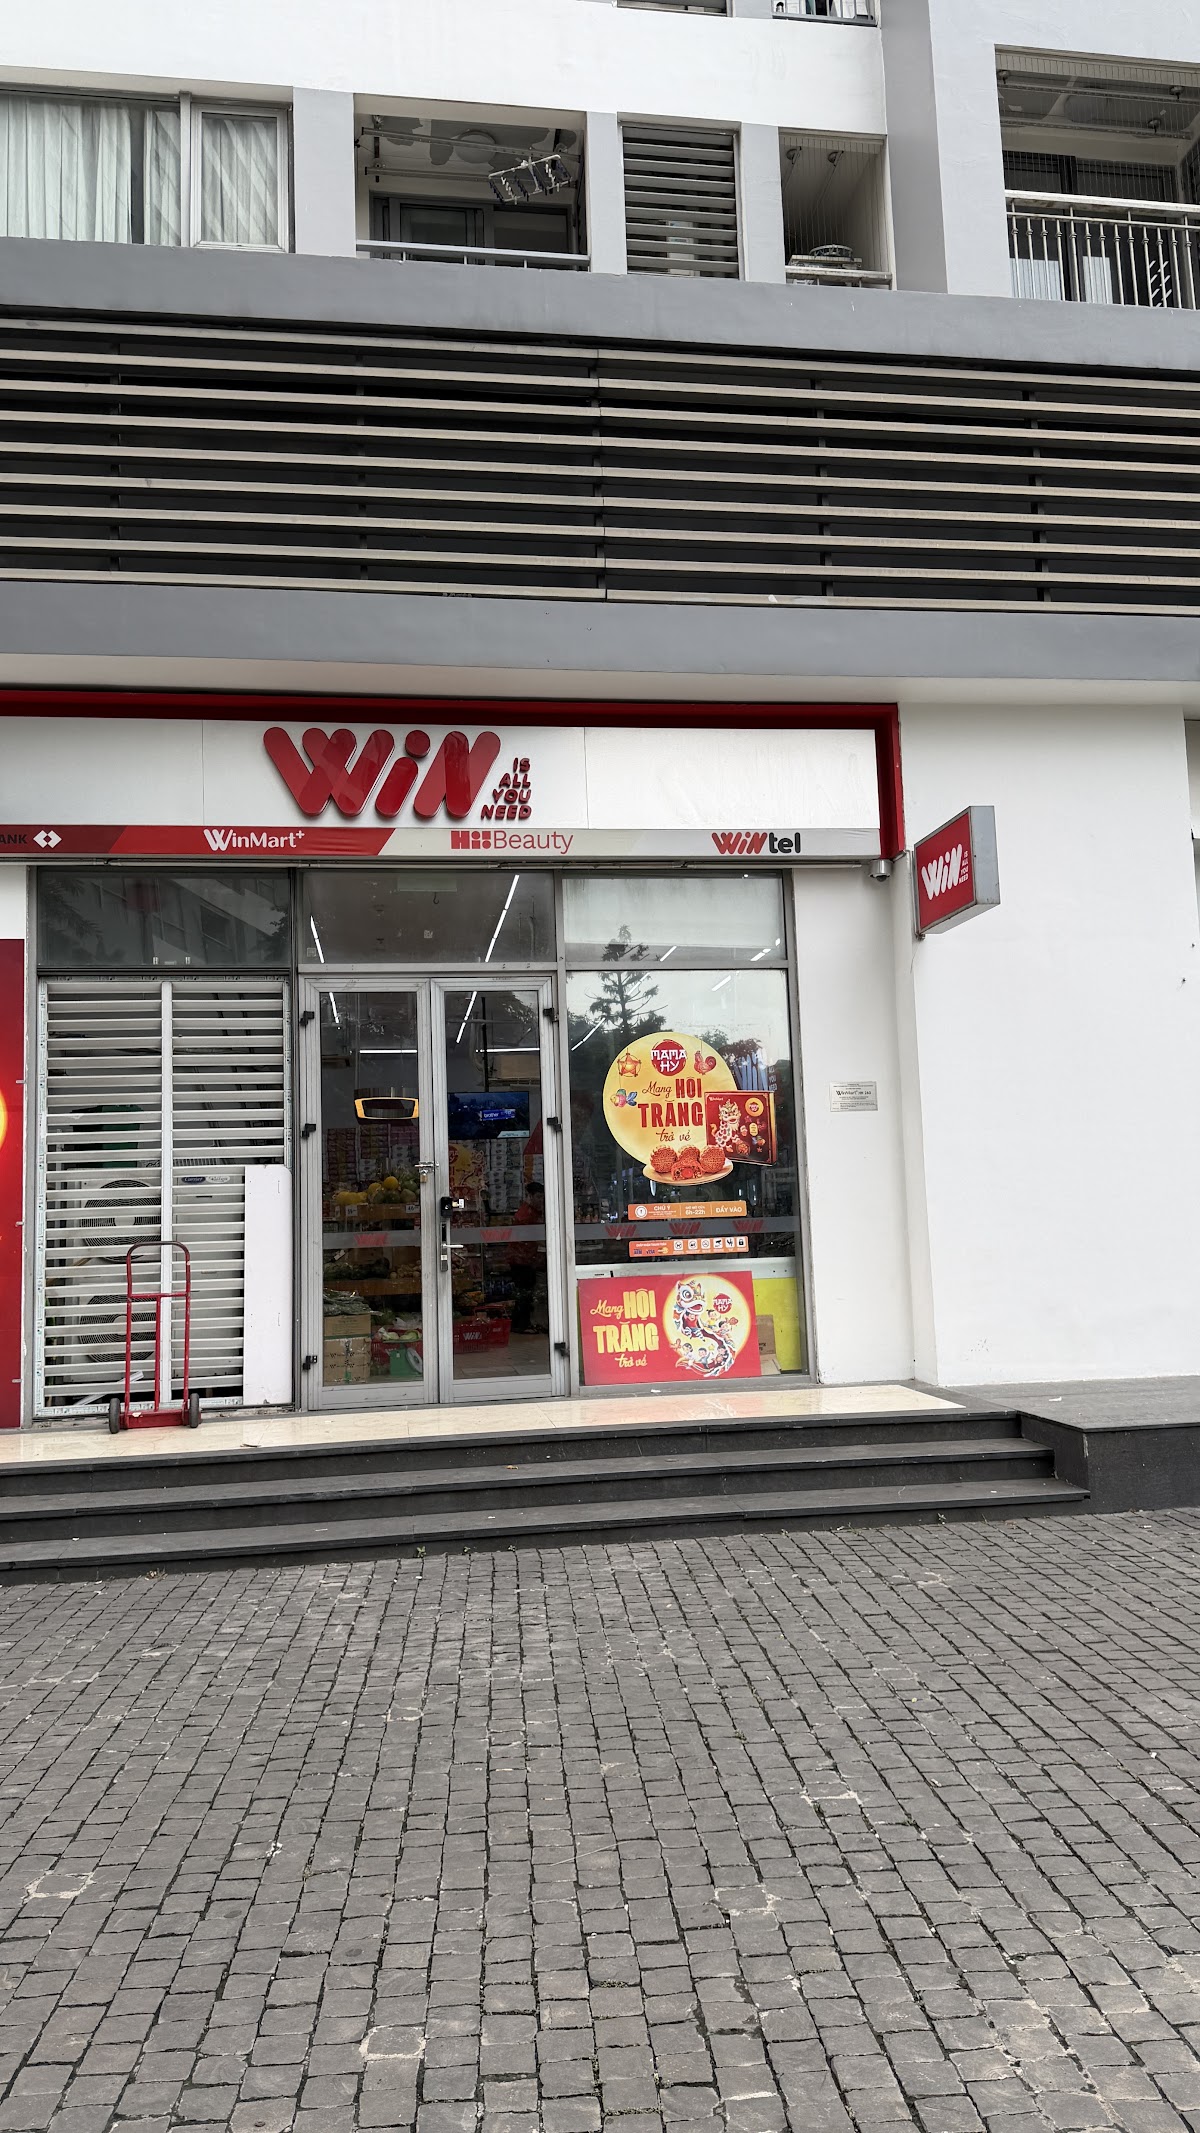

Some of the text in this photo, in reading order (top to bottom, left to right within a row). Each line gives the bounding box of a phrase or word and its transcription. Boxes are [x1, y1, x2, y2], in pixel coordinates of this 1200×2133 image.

[513, 757, 531, 773] IS
[499, 773, 531, 789] ALL
[492, 789, 532, 805] YOU
[481, 804, 532, 821] NEED
[203, 829, 305, 851] WinMart+
[651, 1050, 687, 1060] MAMA
[660, 1061, 680, 1073] HY
[642, 1081, 672, 1098] Mang
[638, 1100, 703, 1127] TRĂNG
[590, 1288, 656, 1320] Mang HỘI
[717, 1304, 728, 1312] HY
[593, 1321, 659, 1353] TRĂNG
